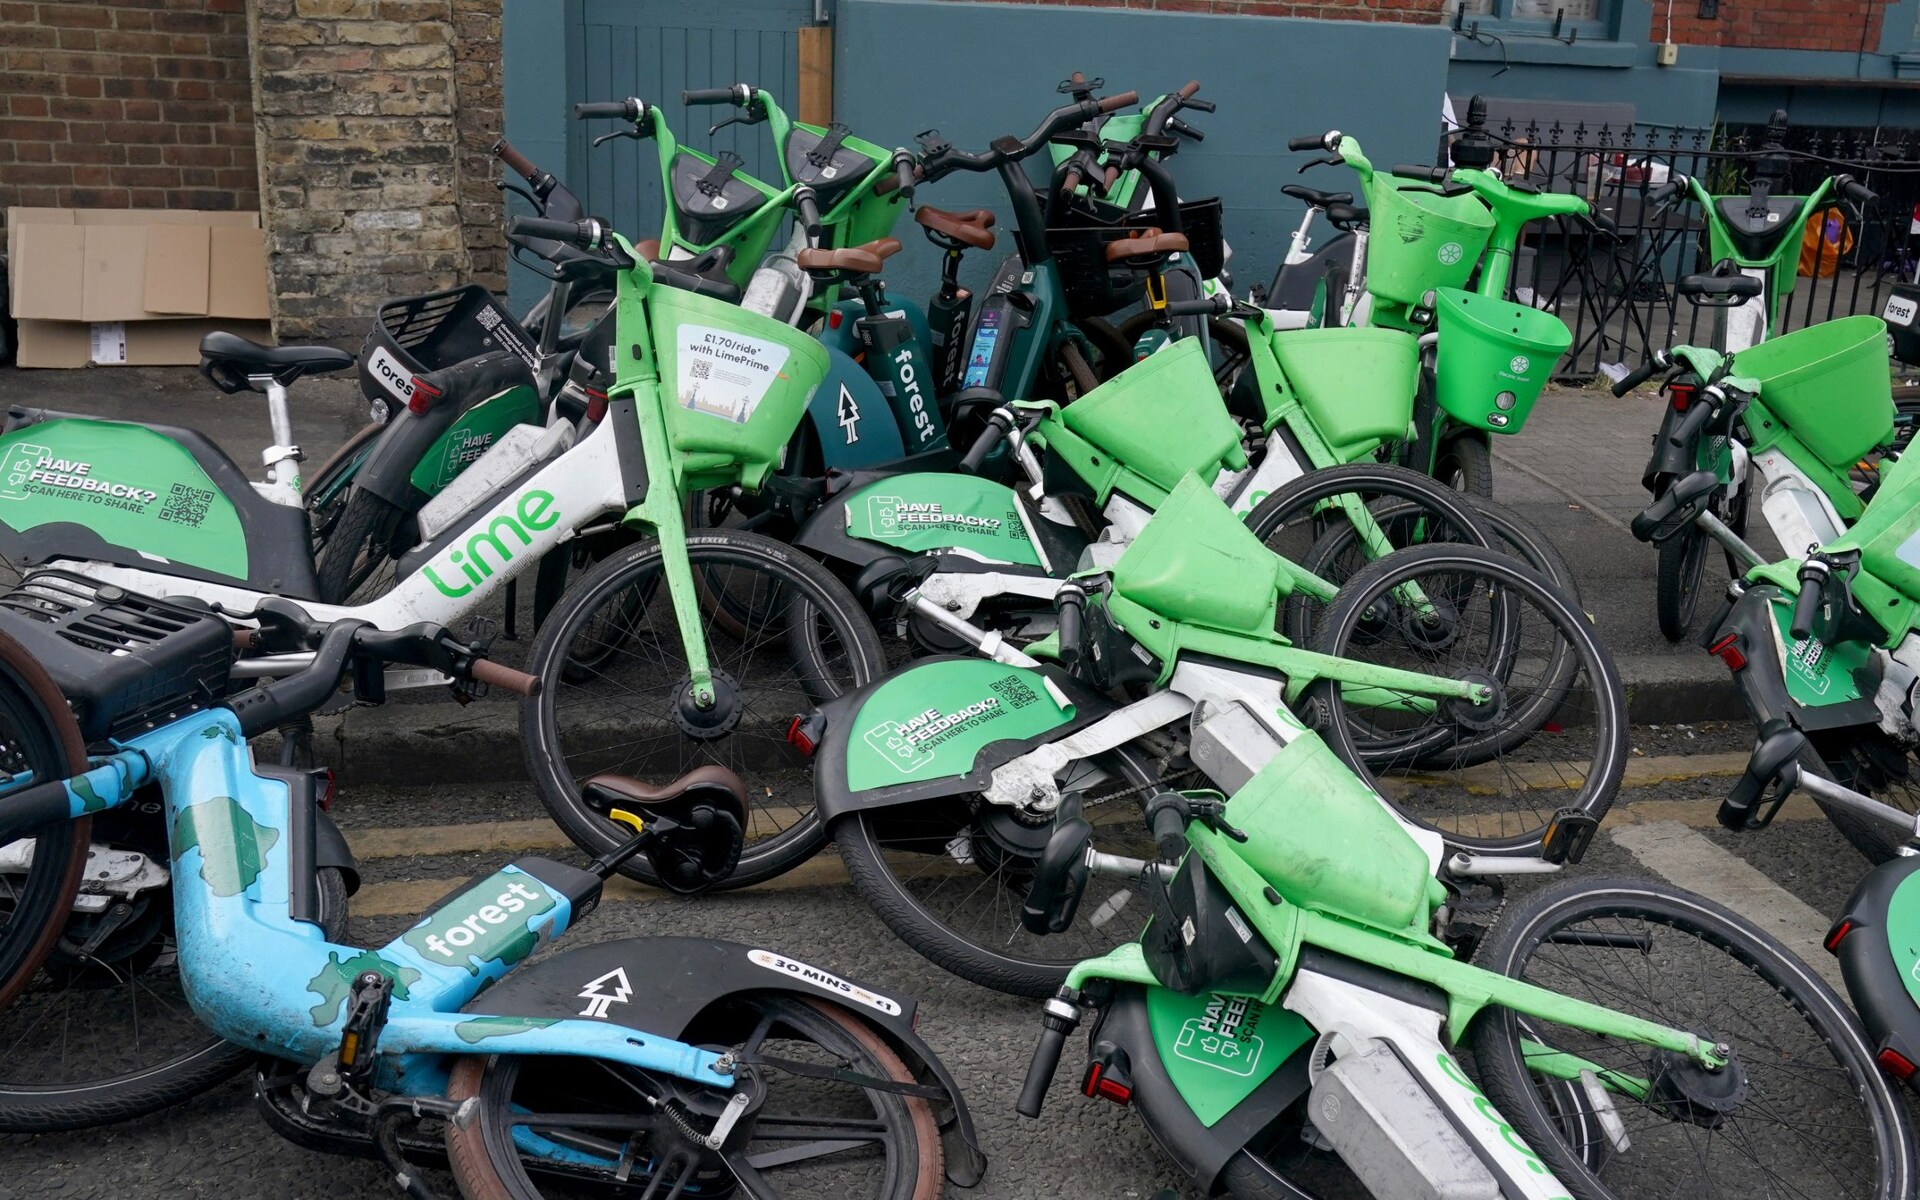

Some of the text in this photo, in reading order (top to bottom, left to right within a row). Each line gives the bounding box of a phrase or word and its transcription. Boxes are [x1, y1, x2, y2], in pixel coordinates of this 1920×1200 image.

[1887, 302, 1911, 319] forest
[690, 343, 770, 372] with LimePrime
[942, 310, 966, 388] forest
[376, 358, 414, 396] fores
[895, 349, 935, 442] forest
[462, 432, 493, 449] HAVE
[35, 456, 92, 476] HAVE
[22, 484, 145, 515] SCAN HERE TO SHARE.
[28, 470, 157, 505] FEEDBACK?
[896, 503, 942, 513] HAVE
[897, 513, 1002, 530] FEEDBACK?
[952, 525, 966, 533] TO
[967, 527, 1000, 537] SHARE.
[894, 708, 943, 738] HAVE
[906, 697, 1001, 747] FEEDBACK?
[917, 709, 1009, 754] SCAN HERE TO SHARE.
[425, 882, 540, 957] forest
[775, 959, 800, 973] 30
[802, 969, 851, 992] MINS
[1198, 993, 1227, 1033] HAV
[1240, 1013, 1259, 1044] SCAN
